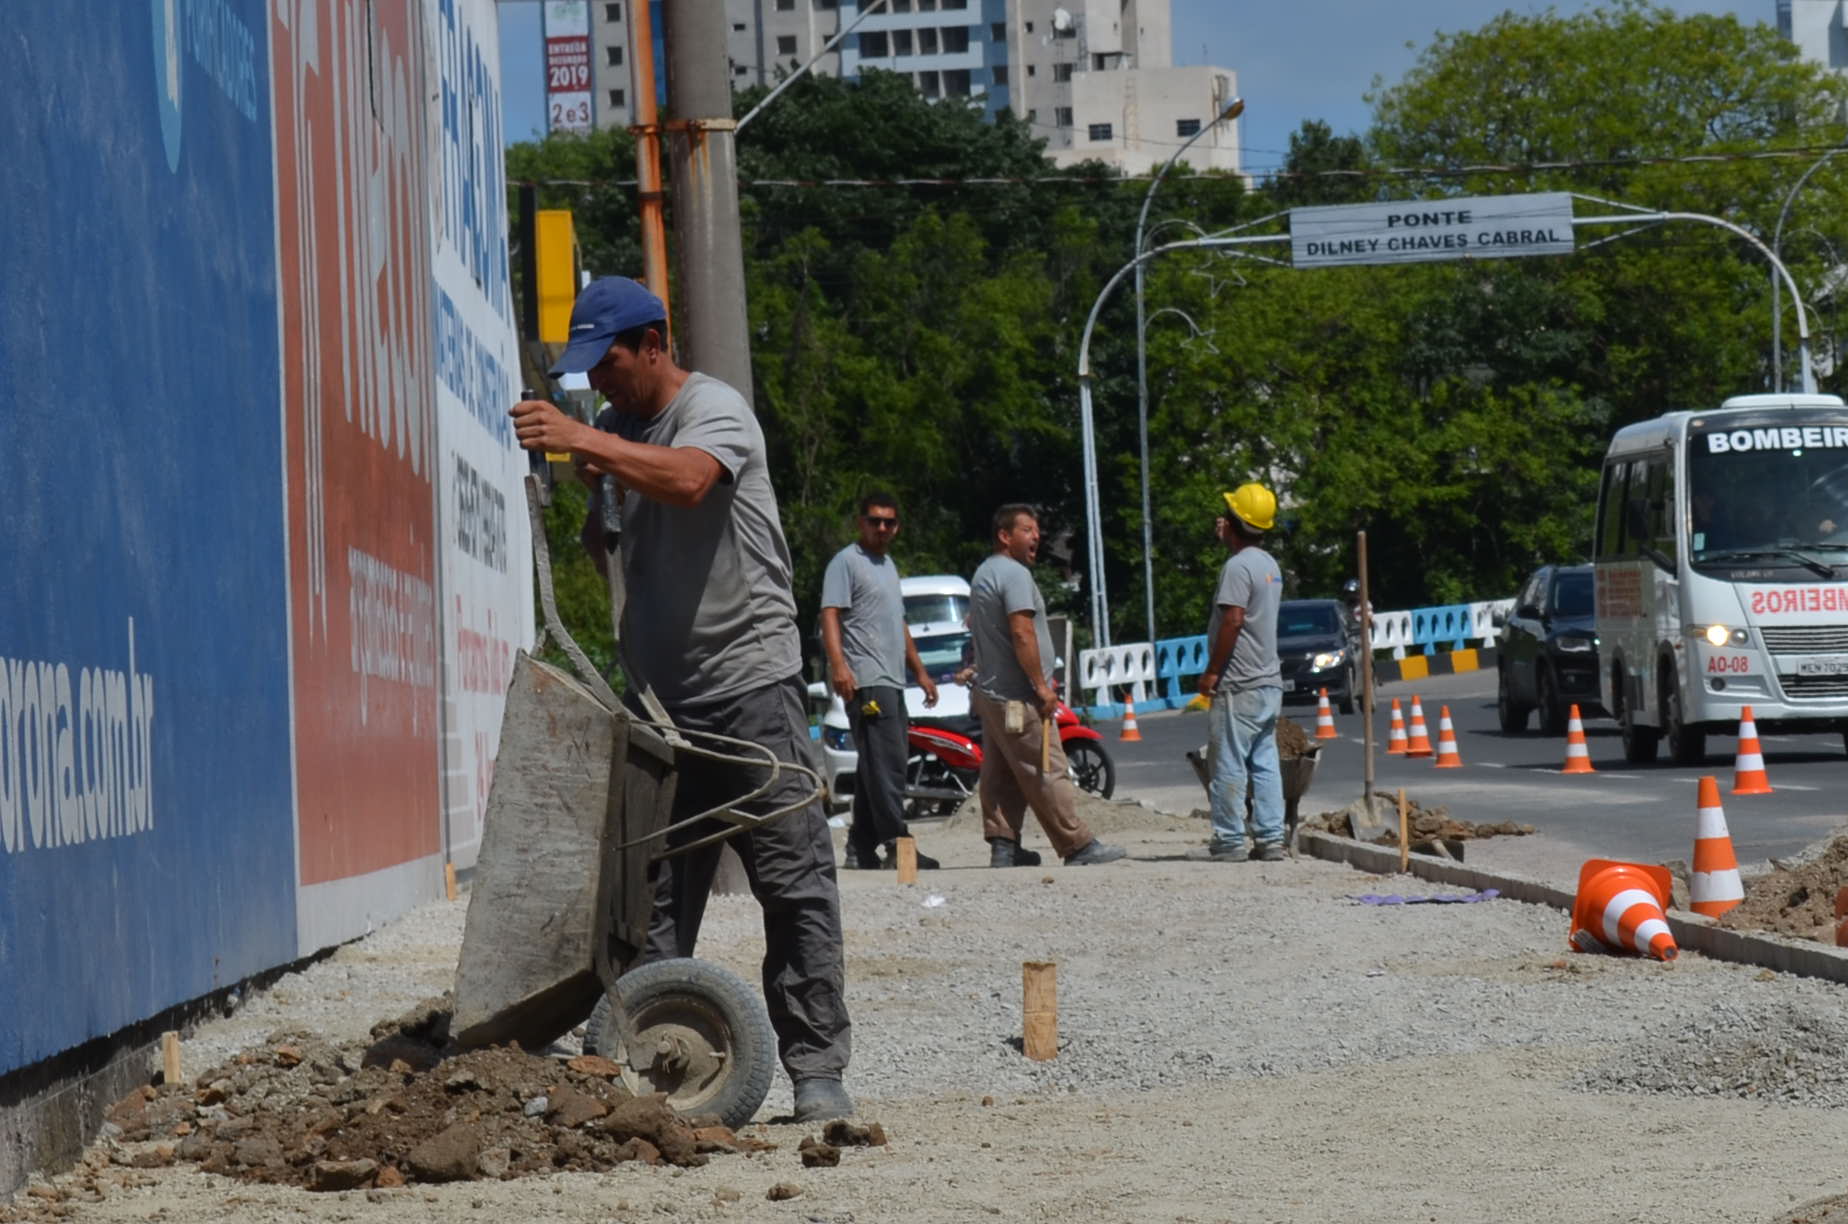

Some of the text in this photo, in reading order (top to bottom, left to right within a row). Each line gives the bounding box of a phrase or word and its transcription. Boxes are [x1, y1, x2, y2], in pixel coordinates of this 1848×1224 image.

[550, 65, 588, 88] 2019
[552, 103, 562, 124] 2
[579, 101, 589, 122] 3
[1387, 210, 1473, 228] PONTE
[1307, 228, 1561, 256] DILNEY CHAVES CABRAL
